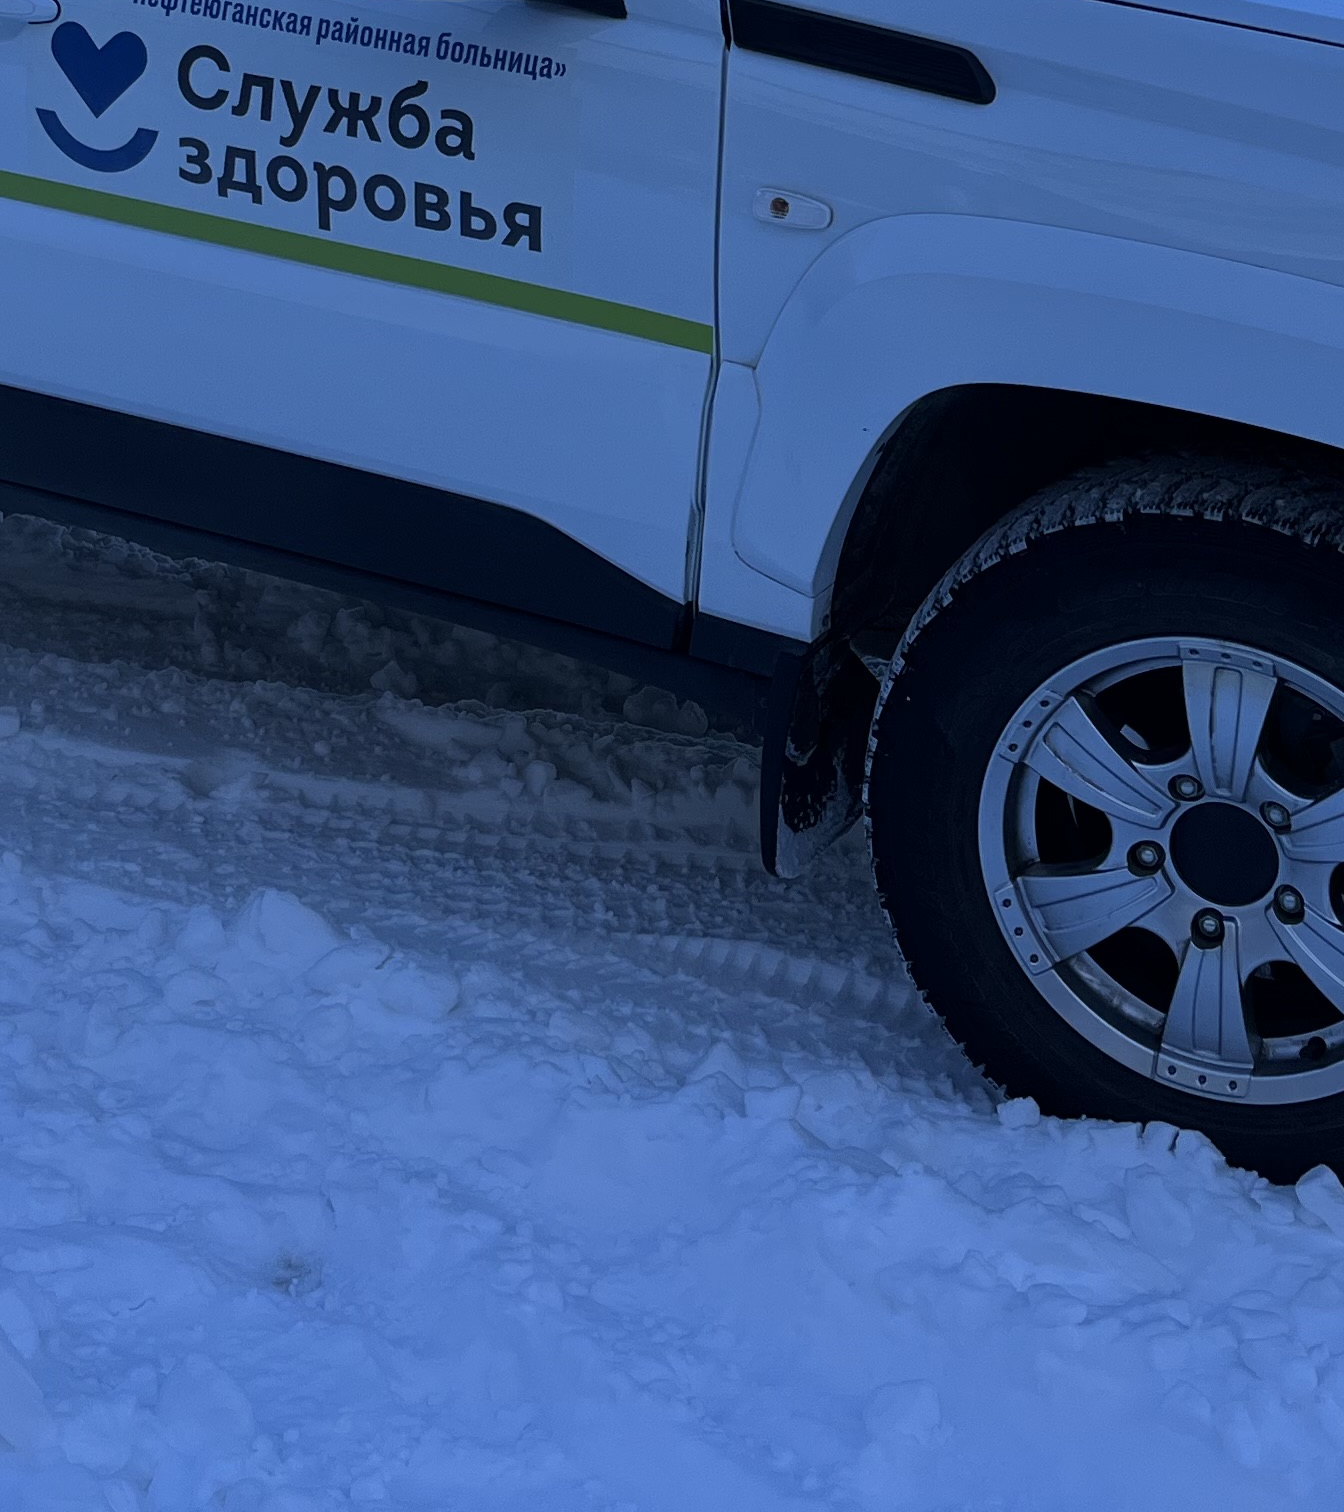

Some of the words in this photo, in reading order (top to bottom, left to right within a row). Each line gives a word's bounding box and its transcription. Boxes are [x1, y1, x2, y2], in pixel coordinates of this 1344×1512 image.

[177, 44, 476, 161] Служба
[315, 17, 431, 57] районная
[435, 32, 567, 80] больница»
[178, 137, 542, 252] здоровья
